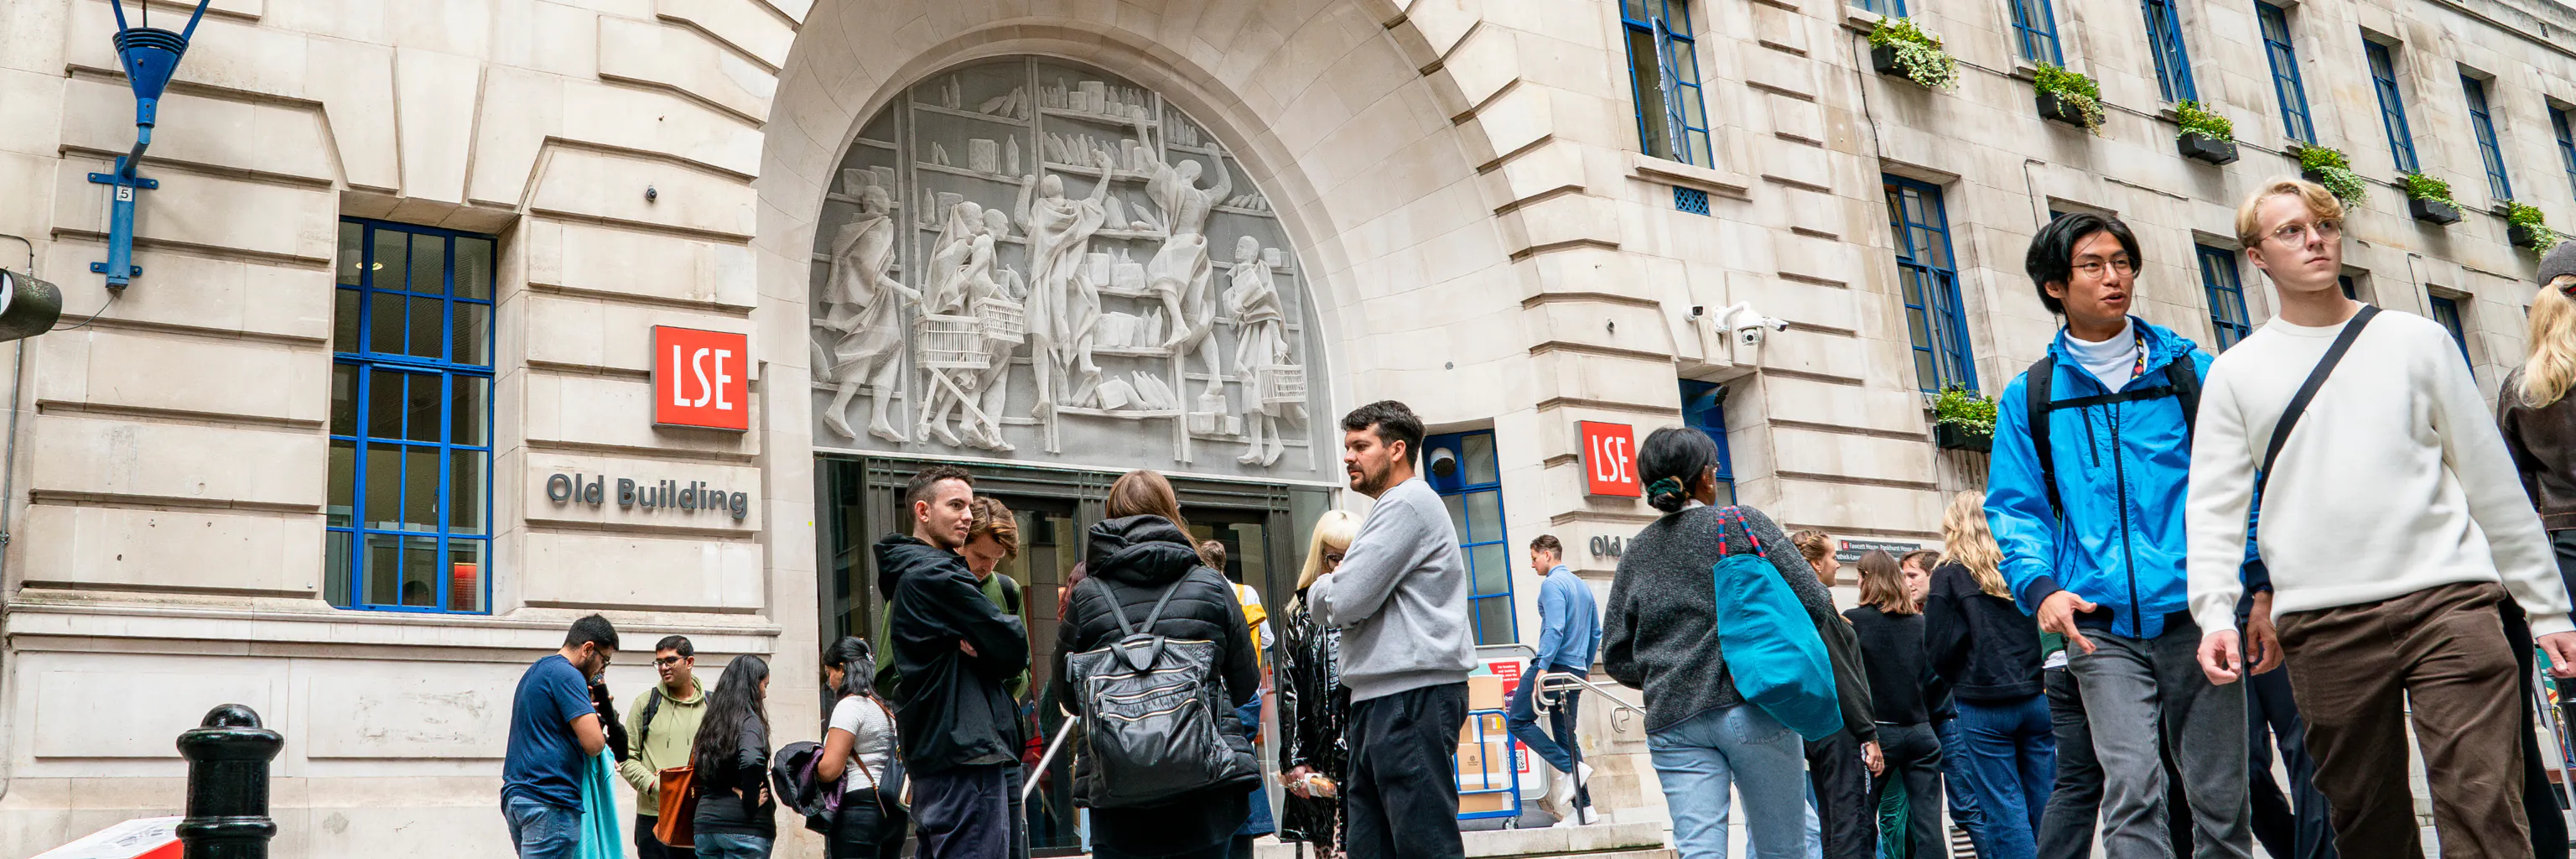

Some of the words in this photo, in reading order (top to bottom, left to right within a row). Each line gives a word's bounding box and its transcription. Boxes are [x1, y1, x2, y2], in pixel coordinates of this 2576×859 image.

[121, 189, 129, 199] 5
[673, 345, 732, 410] LSE
[1592, 435, 1631, 483] LSE
[547, 473, 604, 504] Old
[617, 477, 748, 519] Building
[1590, 535, 1623, 558] Old
